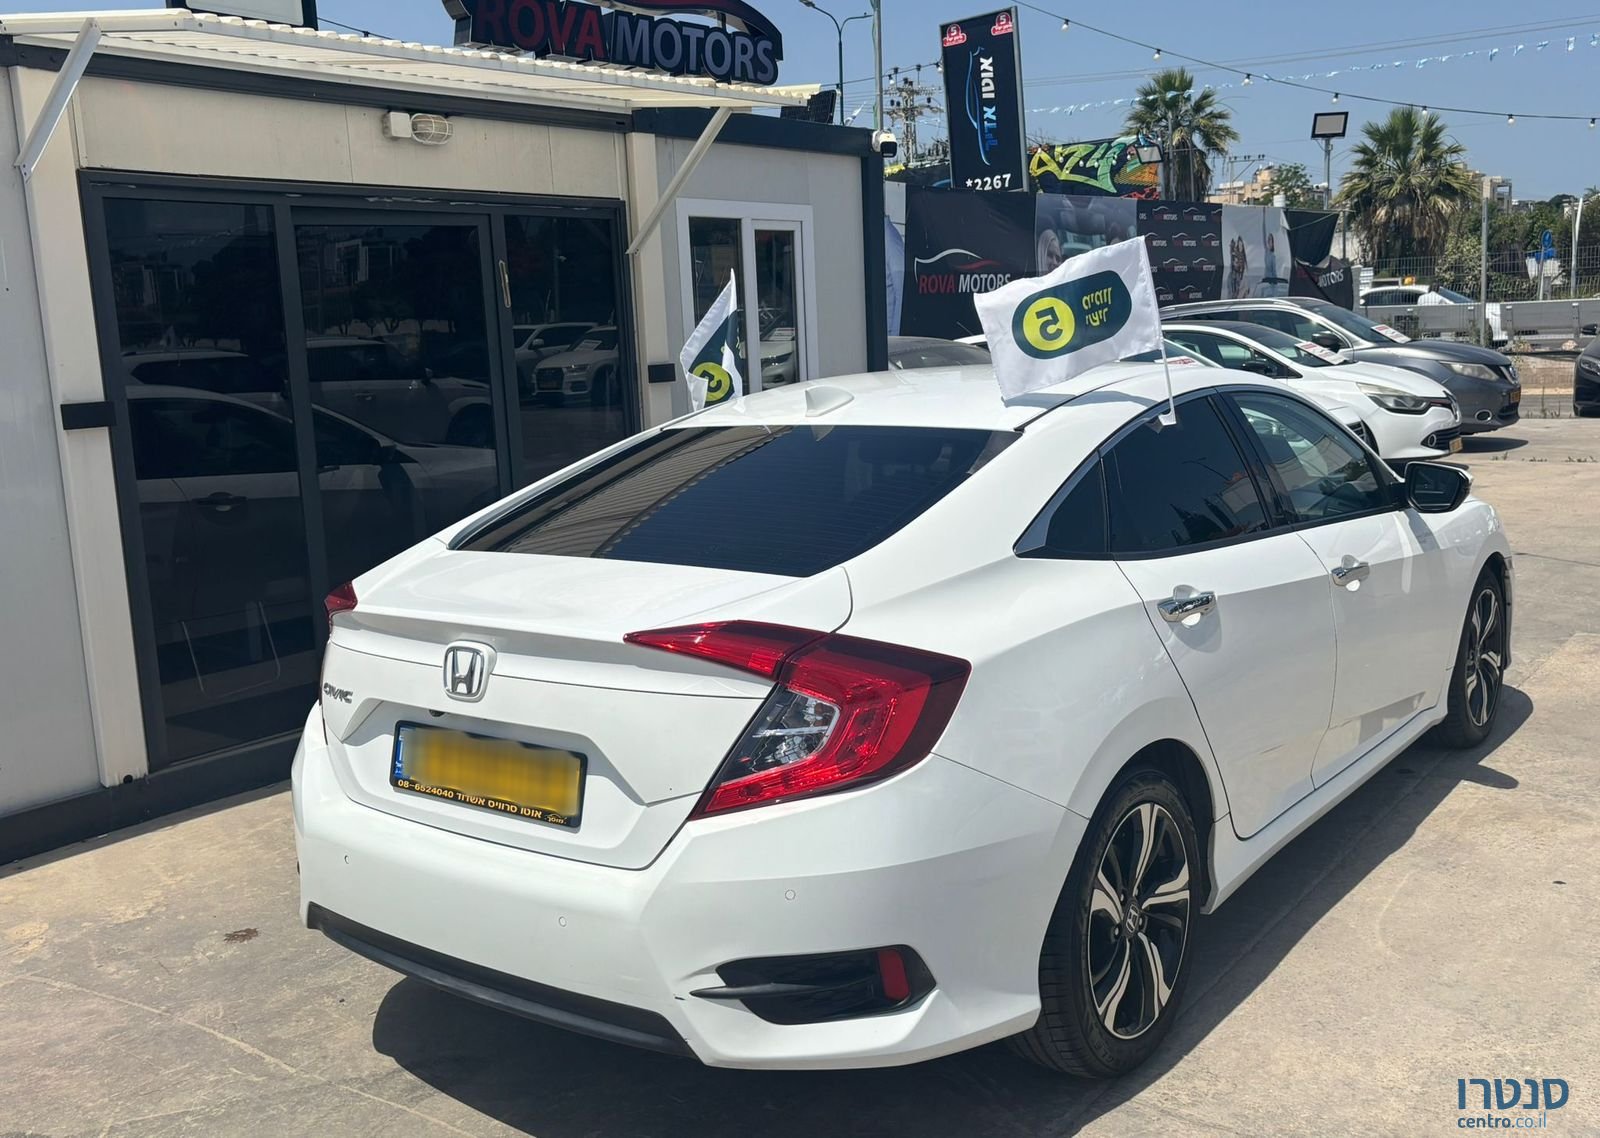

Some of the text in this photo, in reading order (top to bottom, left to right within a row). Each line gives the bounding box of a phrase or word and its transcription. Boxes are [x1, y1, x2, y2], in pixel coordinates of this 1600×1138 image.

[476, 0, 775, 82] ROVA MOTORS
[980, 56, 995, 99] אוטו
[918, 274, 956, 294] ROVA
[323, 682, 354, 705] CIVIC
[398, 779, 542, 819] אוטו סרוויס אשדוד 08-6524040
